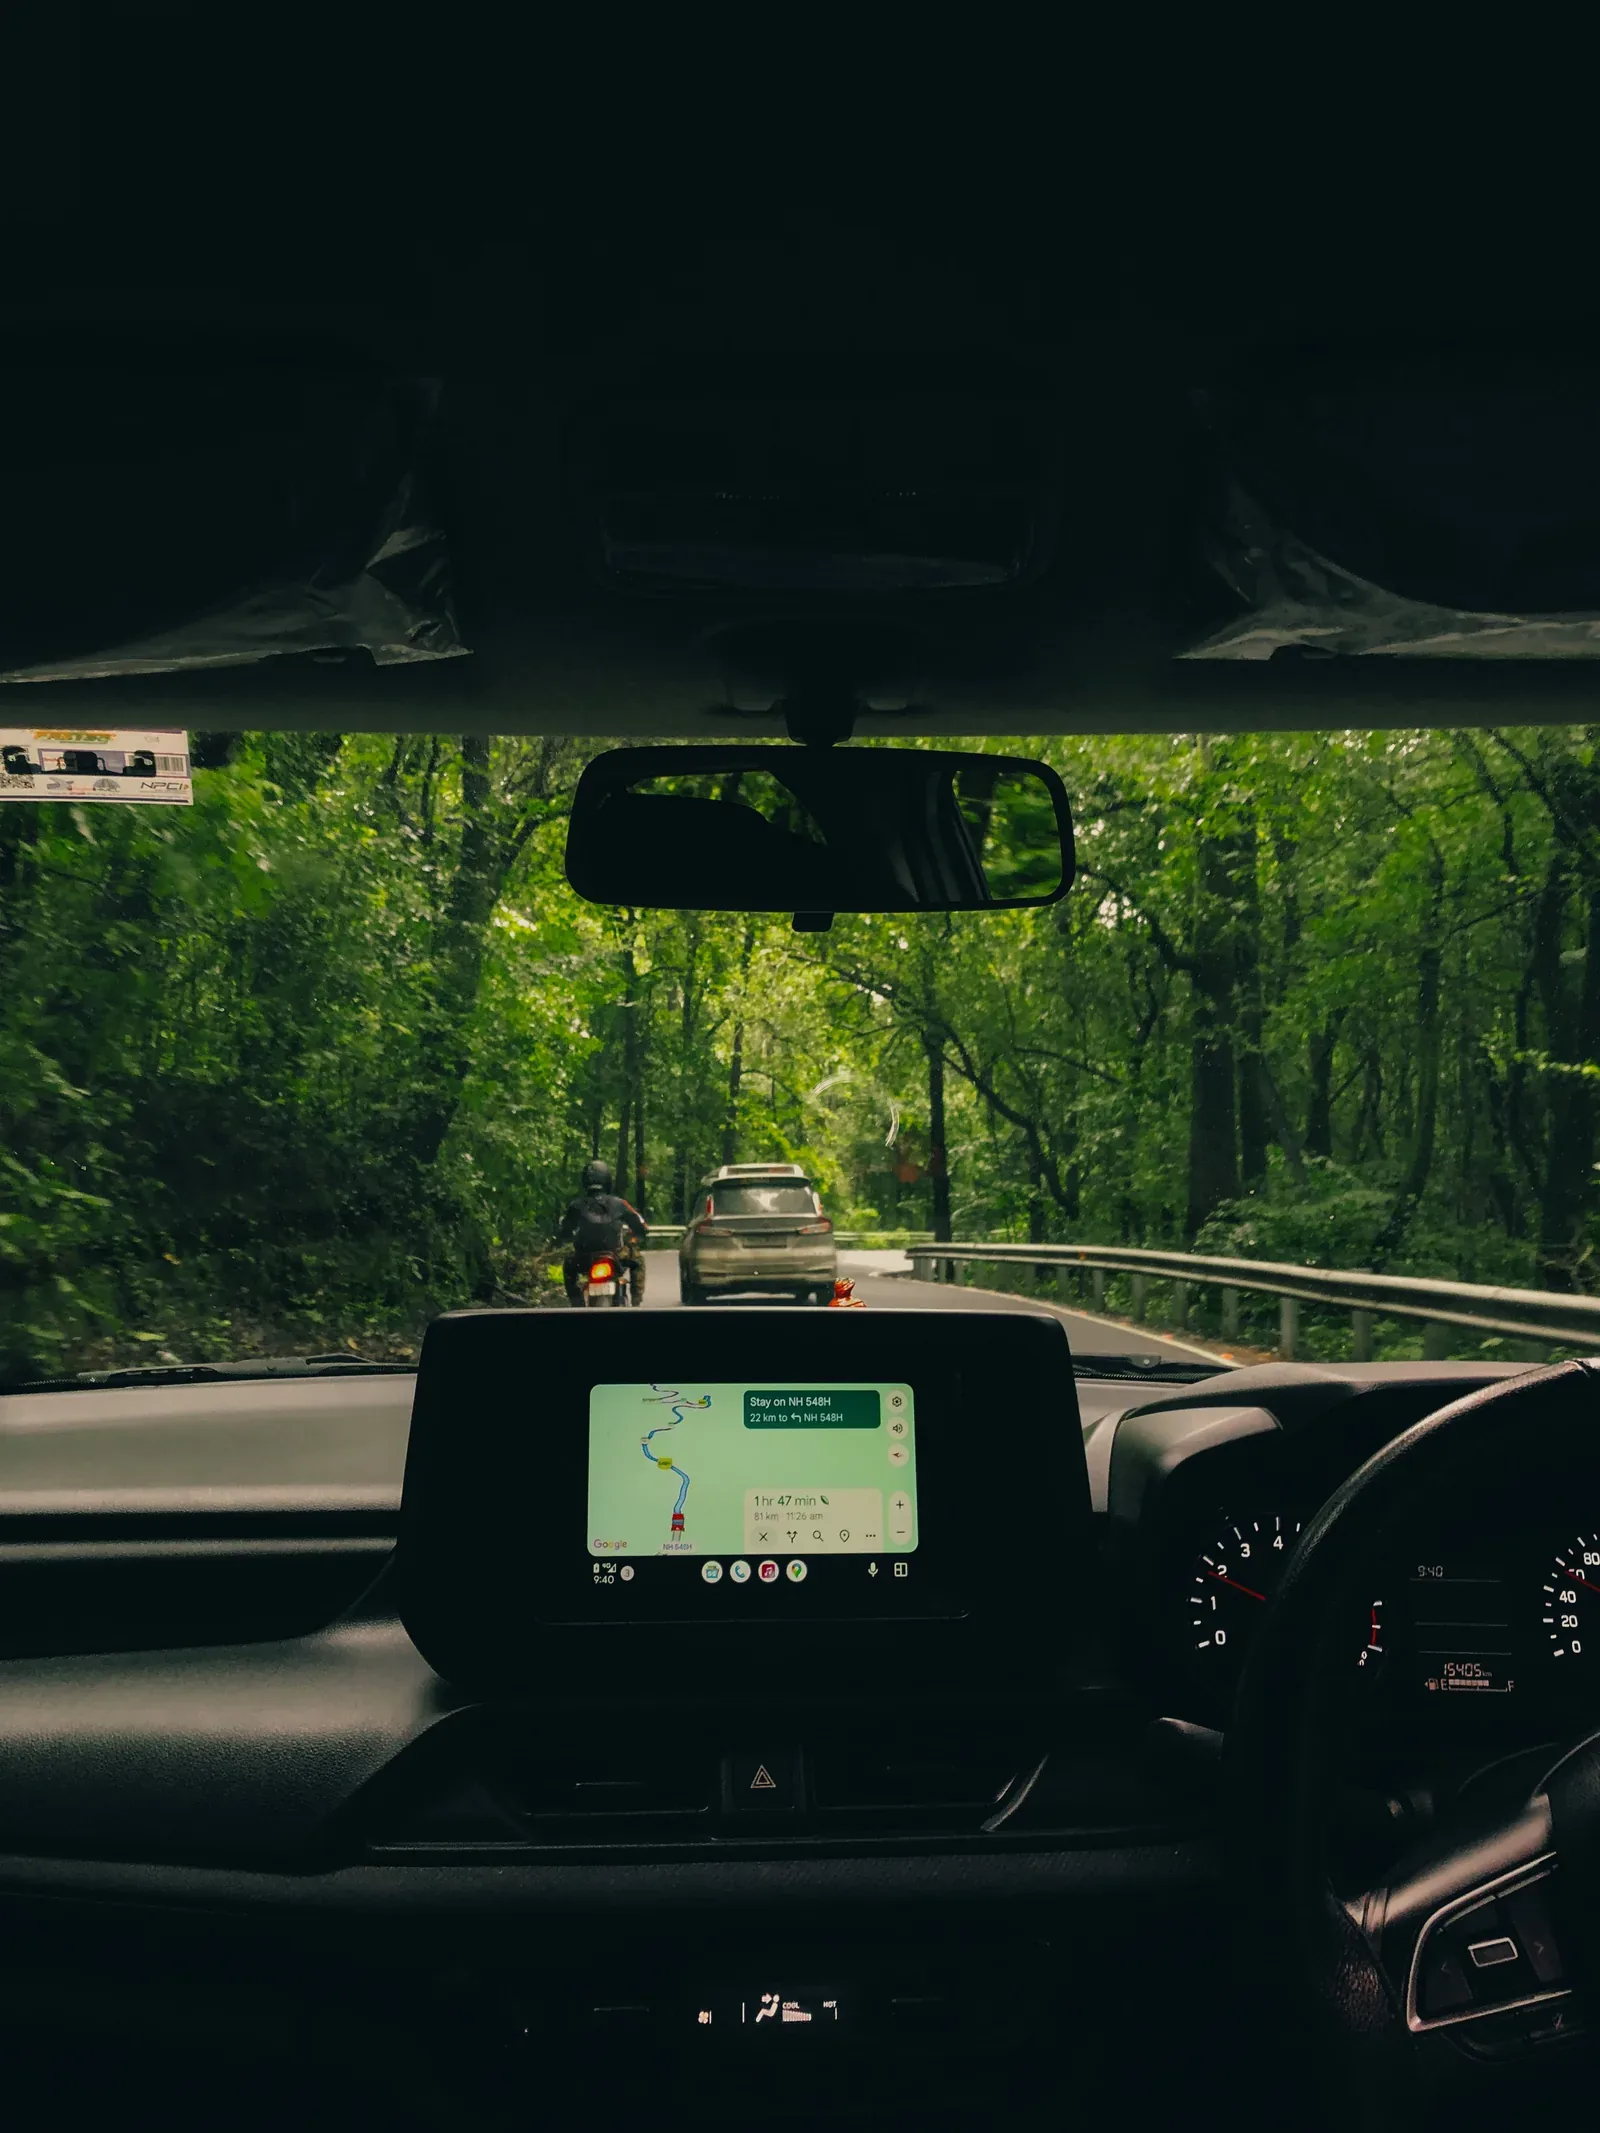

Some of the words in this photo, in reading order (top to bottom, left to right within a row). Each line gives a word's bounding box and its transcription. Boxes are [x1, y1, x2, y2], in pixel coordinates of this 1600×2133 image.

[140, 781, 183, 790] NPCI
[750, 1397, 770, 1409] Stay
[773, 1399, 786, 1407] on
[788, 1397, 804, 1407] NH
[805, 1397, 831, 1407] 548H
[750, 1413, 761, 1422] 22
[763, 1413, 776, 1422] km
[778, 1413, 788, 1422] to
[804, 1413, 818, 1422] NH
[820, 1413, 843, 1422] 548H
[754, 1496, 760, 1506] 1
[762, 1496, 774, 1506] hr
[777, 1496, 792, 1506] 47
[794, 1495, 817, 1506] min
[754, 1512, 764, 1521] 81
[765, 1512, 779, 1521] km
[786, 1511, 807, 1521] 11:26
[809, 1512, 824, 1521] am
[593, 1538, 628, 1551] Google
[1273, 1535, 1283, 1550] 4
[1240, 1543, 1250, 1558] 3
[1583, 1552, 1600, 1566] 80
[624, 1568, 630, 1578] 3
[1217, 1564, 1228, 1578] 2
[1418, 1565, 1443, 1578] 9:40
[593, 1575, 615, 1585] 9:40
[1210, 1595, 1216, 1610] 1
[1559, 1590, 1577, 1604] 40
[1561, 1614, 1578, 1628] 20
[1215, 1630, 1226, 1645] 0
[1571, 1640, 1582, 1654] 0
[1443, 1662, 1482, 1677] 15405
[1440, 1678, 1448, 1691] E
[1507, 1680, 1515, 1692] F
[782, 2001, 800, 2009] COOL
[823, 2000, 837, 2008] HOT
